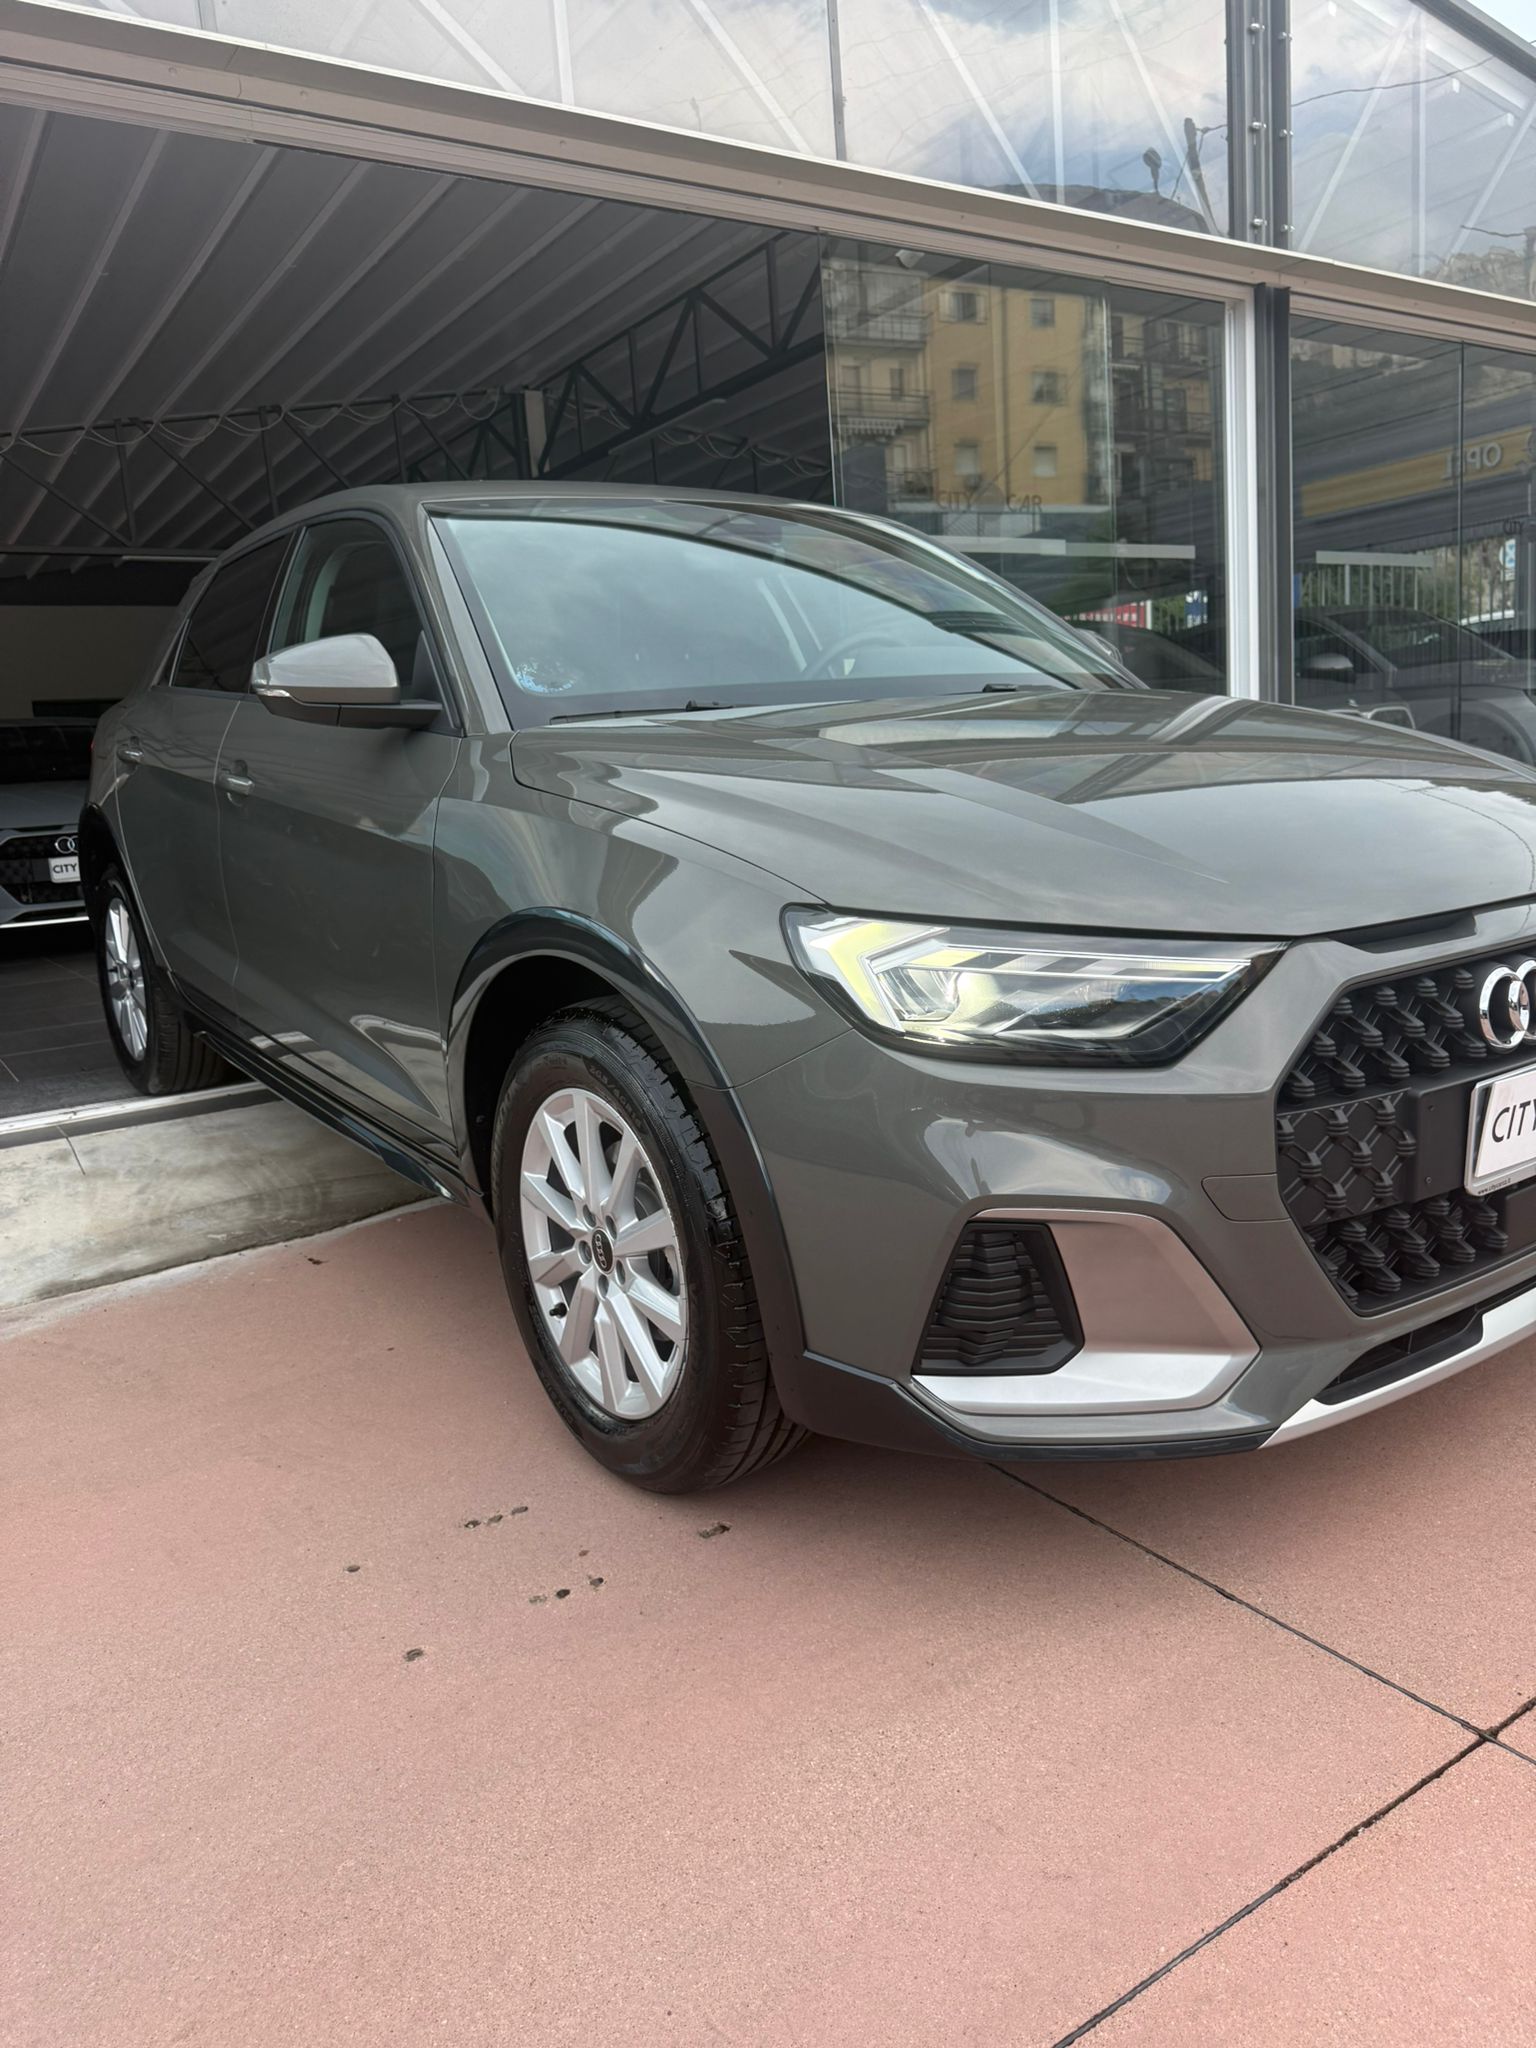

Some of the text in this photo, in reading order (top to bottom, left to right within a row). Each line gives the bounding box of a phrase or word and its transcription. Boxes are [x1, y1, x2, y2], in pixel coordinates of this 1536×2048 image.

[936, 490, 1042, 513] CITY CAR
[53, 863, 77, 874] CITY
